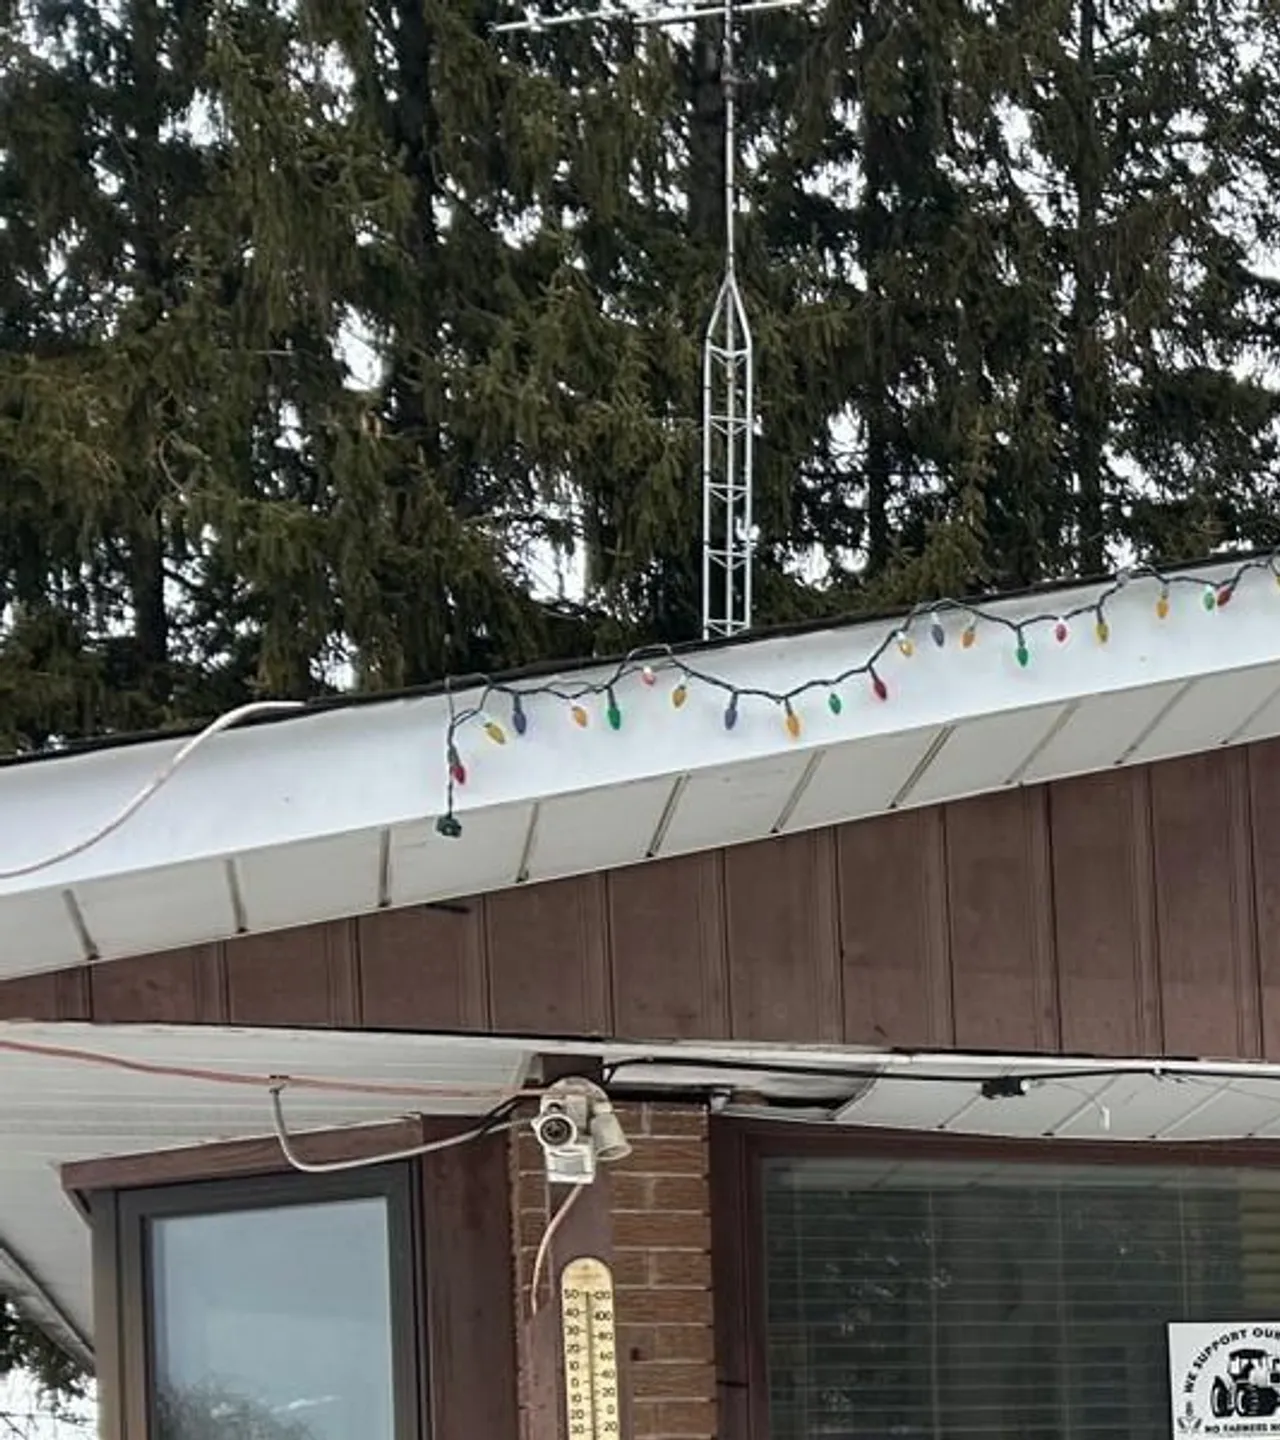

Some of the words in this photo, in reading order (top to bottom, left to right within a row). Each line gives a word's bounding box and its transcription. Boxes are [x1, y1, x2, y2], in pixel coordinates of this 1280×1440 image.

[564, 1289, 579, 1299] 50
[565, 1308, 579, 1318] 40
[567, 1344, 580, 1353] 20
[569, 1361, 580, 1371] 10
[1184, 1373, 1197, 1393] WE
[1194, 1329, 1247, 1368] SUPPORT
[602, 1388, 616, 1398] 20
[604, 1421, 618, 1431] 20
[1205, 1424, 1220, 1434] NO
[1223, 1423, 1268, 1432] FARMERS
